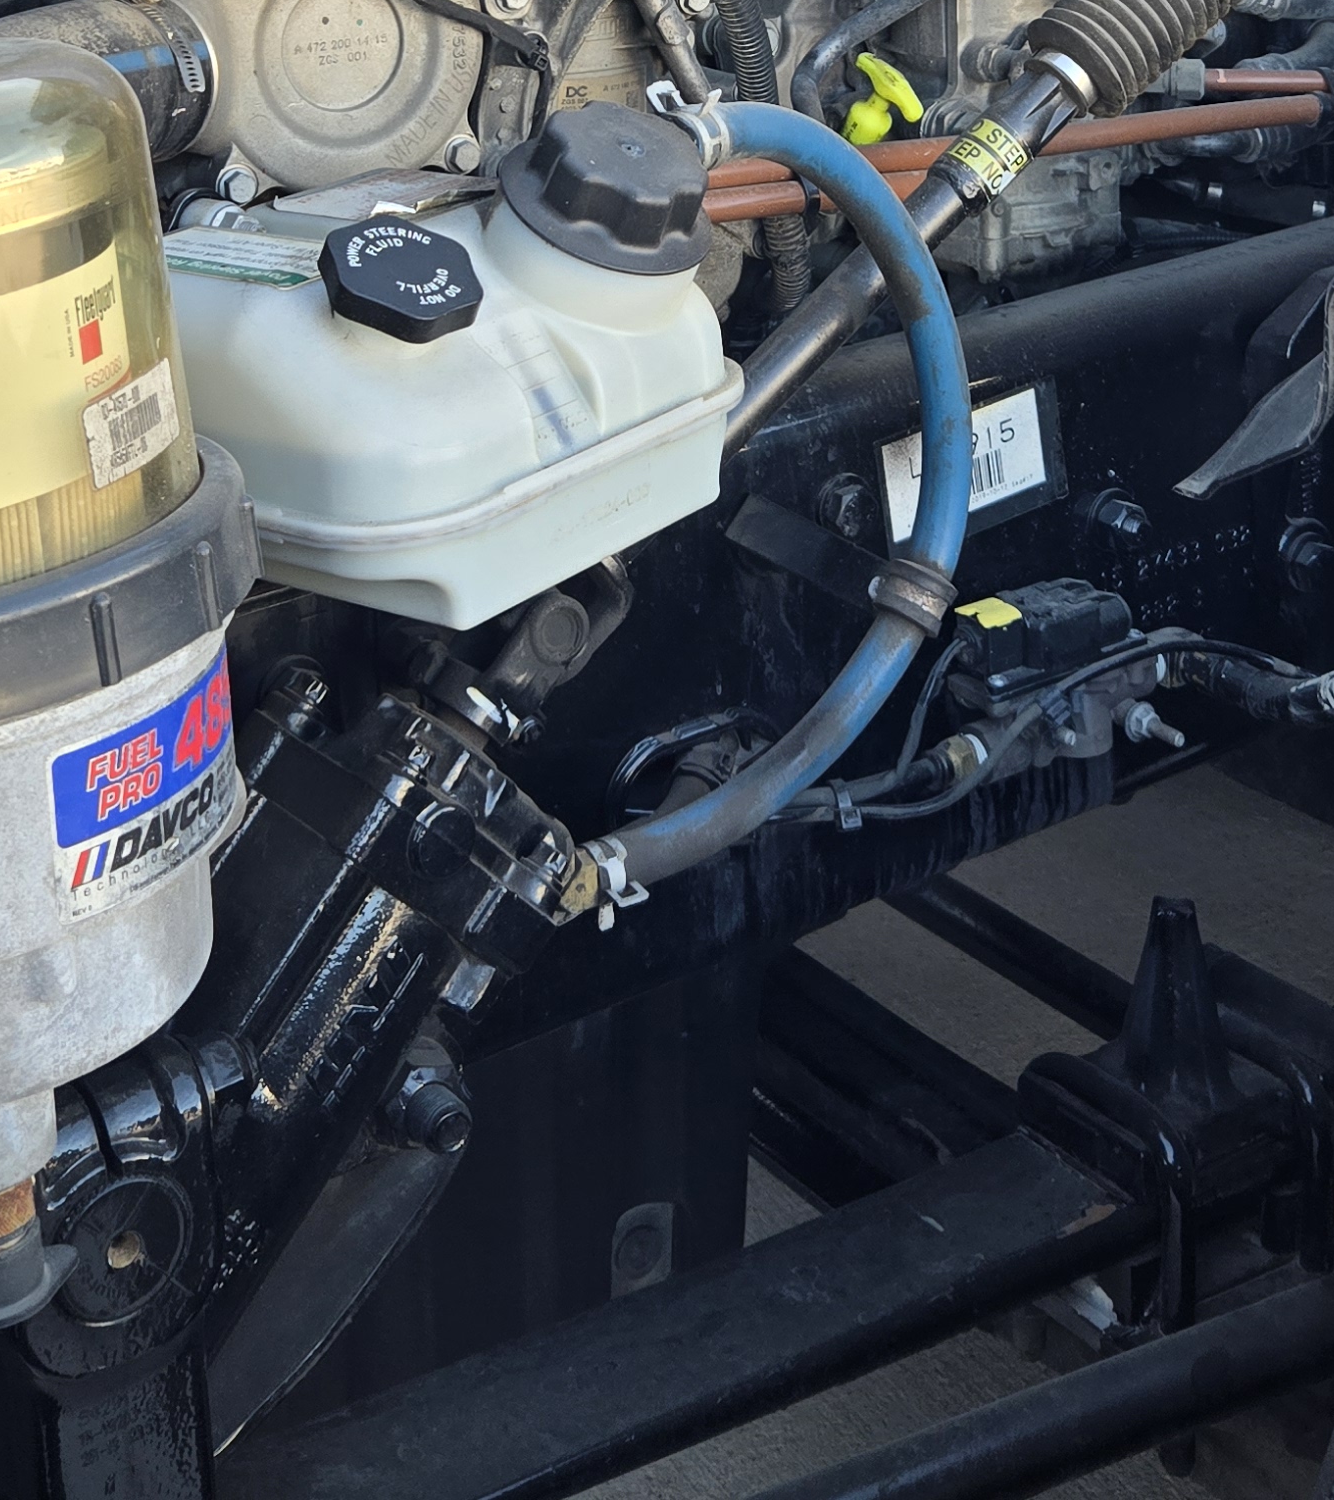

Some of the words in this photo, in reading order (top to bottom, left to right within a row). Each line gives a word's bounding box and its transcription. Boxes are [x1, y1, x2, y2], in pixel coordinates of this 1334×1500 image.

[986, 128, 1025, 167] STEP
[346, 236, 366, 268] POWER
[363, 226, 432, 246] STEERING
[365, 237, 404, 257] FLUID
[395, 268, 449, 294] OVERFILL
[419, 293, 446, 306] NOT
[444, 284, 462, 299] DO
[86, 728, 164, 792] FUEL
[97, 761, 163, 822] PRO
[110, 772, 214, 873] DAVCO
